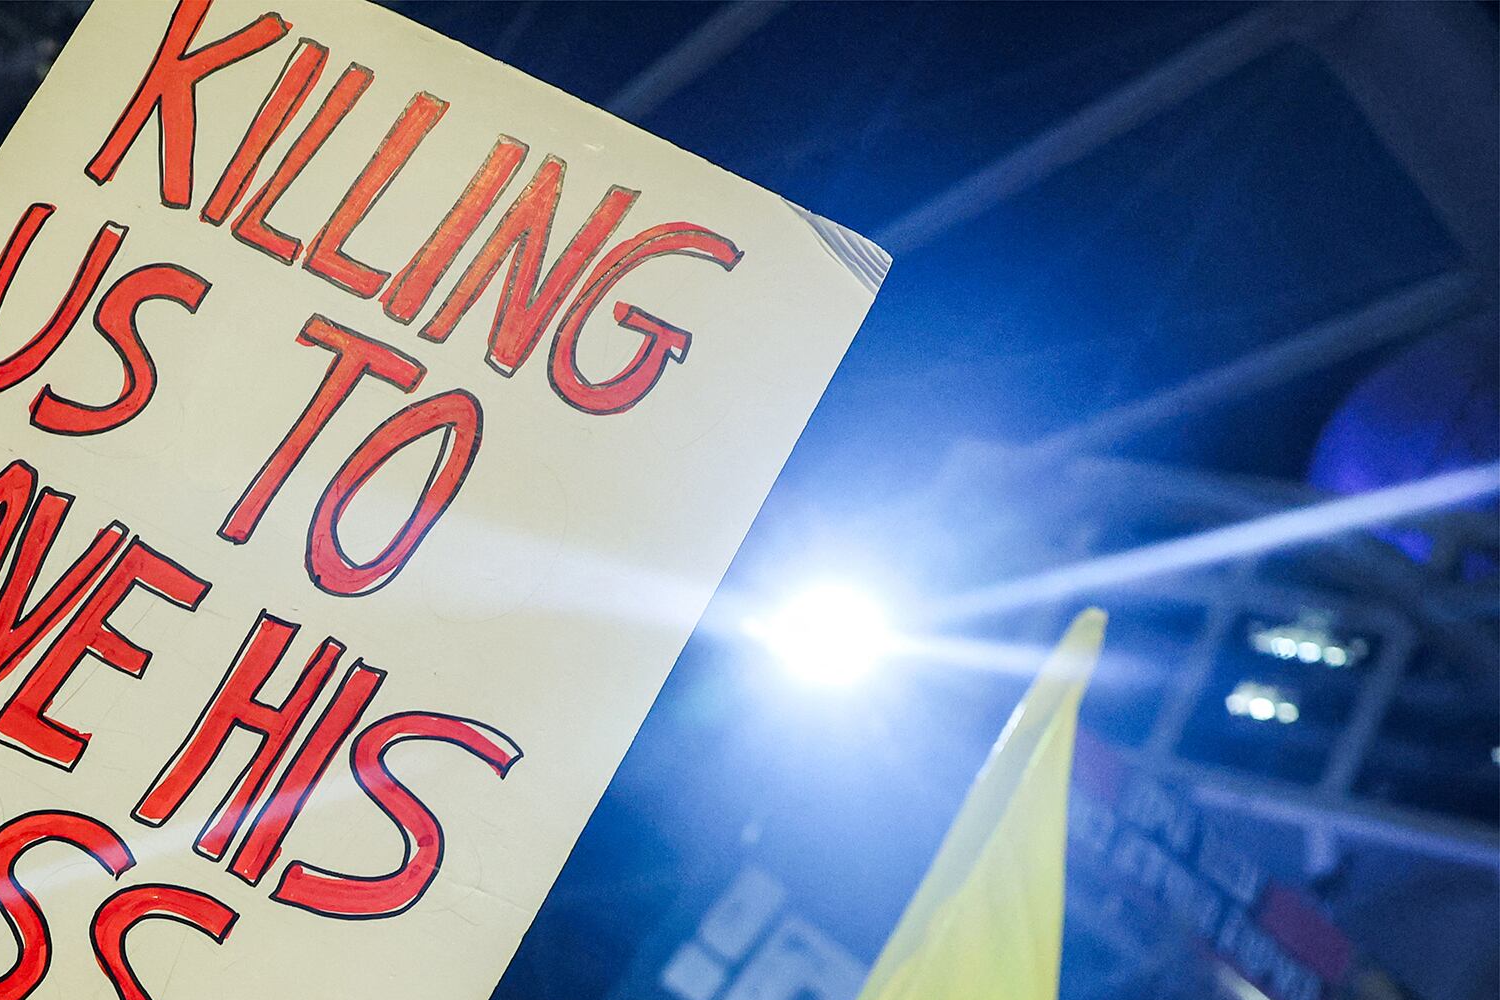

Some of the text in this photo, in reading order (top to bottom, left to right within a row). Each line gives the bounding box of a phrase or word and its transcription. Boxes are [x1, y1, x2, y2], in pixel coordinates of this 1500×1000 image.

[85, 0, 743, 416] KILLING
[218, 314, 483, 598] TO
[130, 609, 523, 920] HIS
